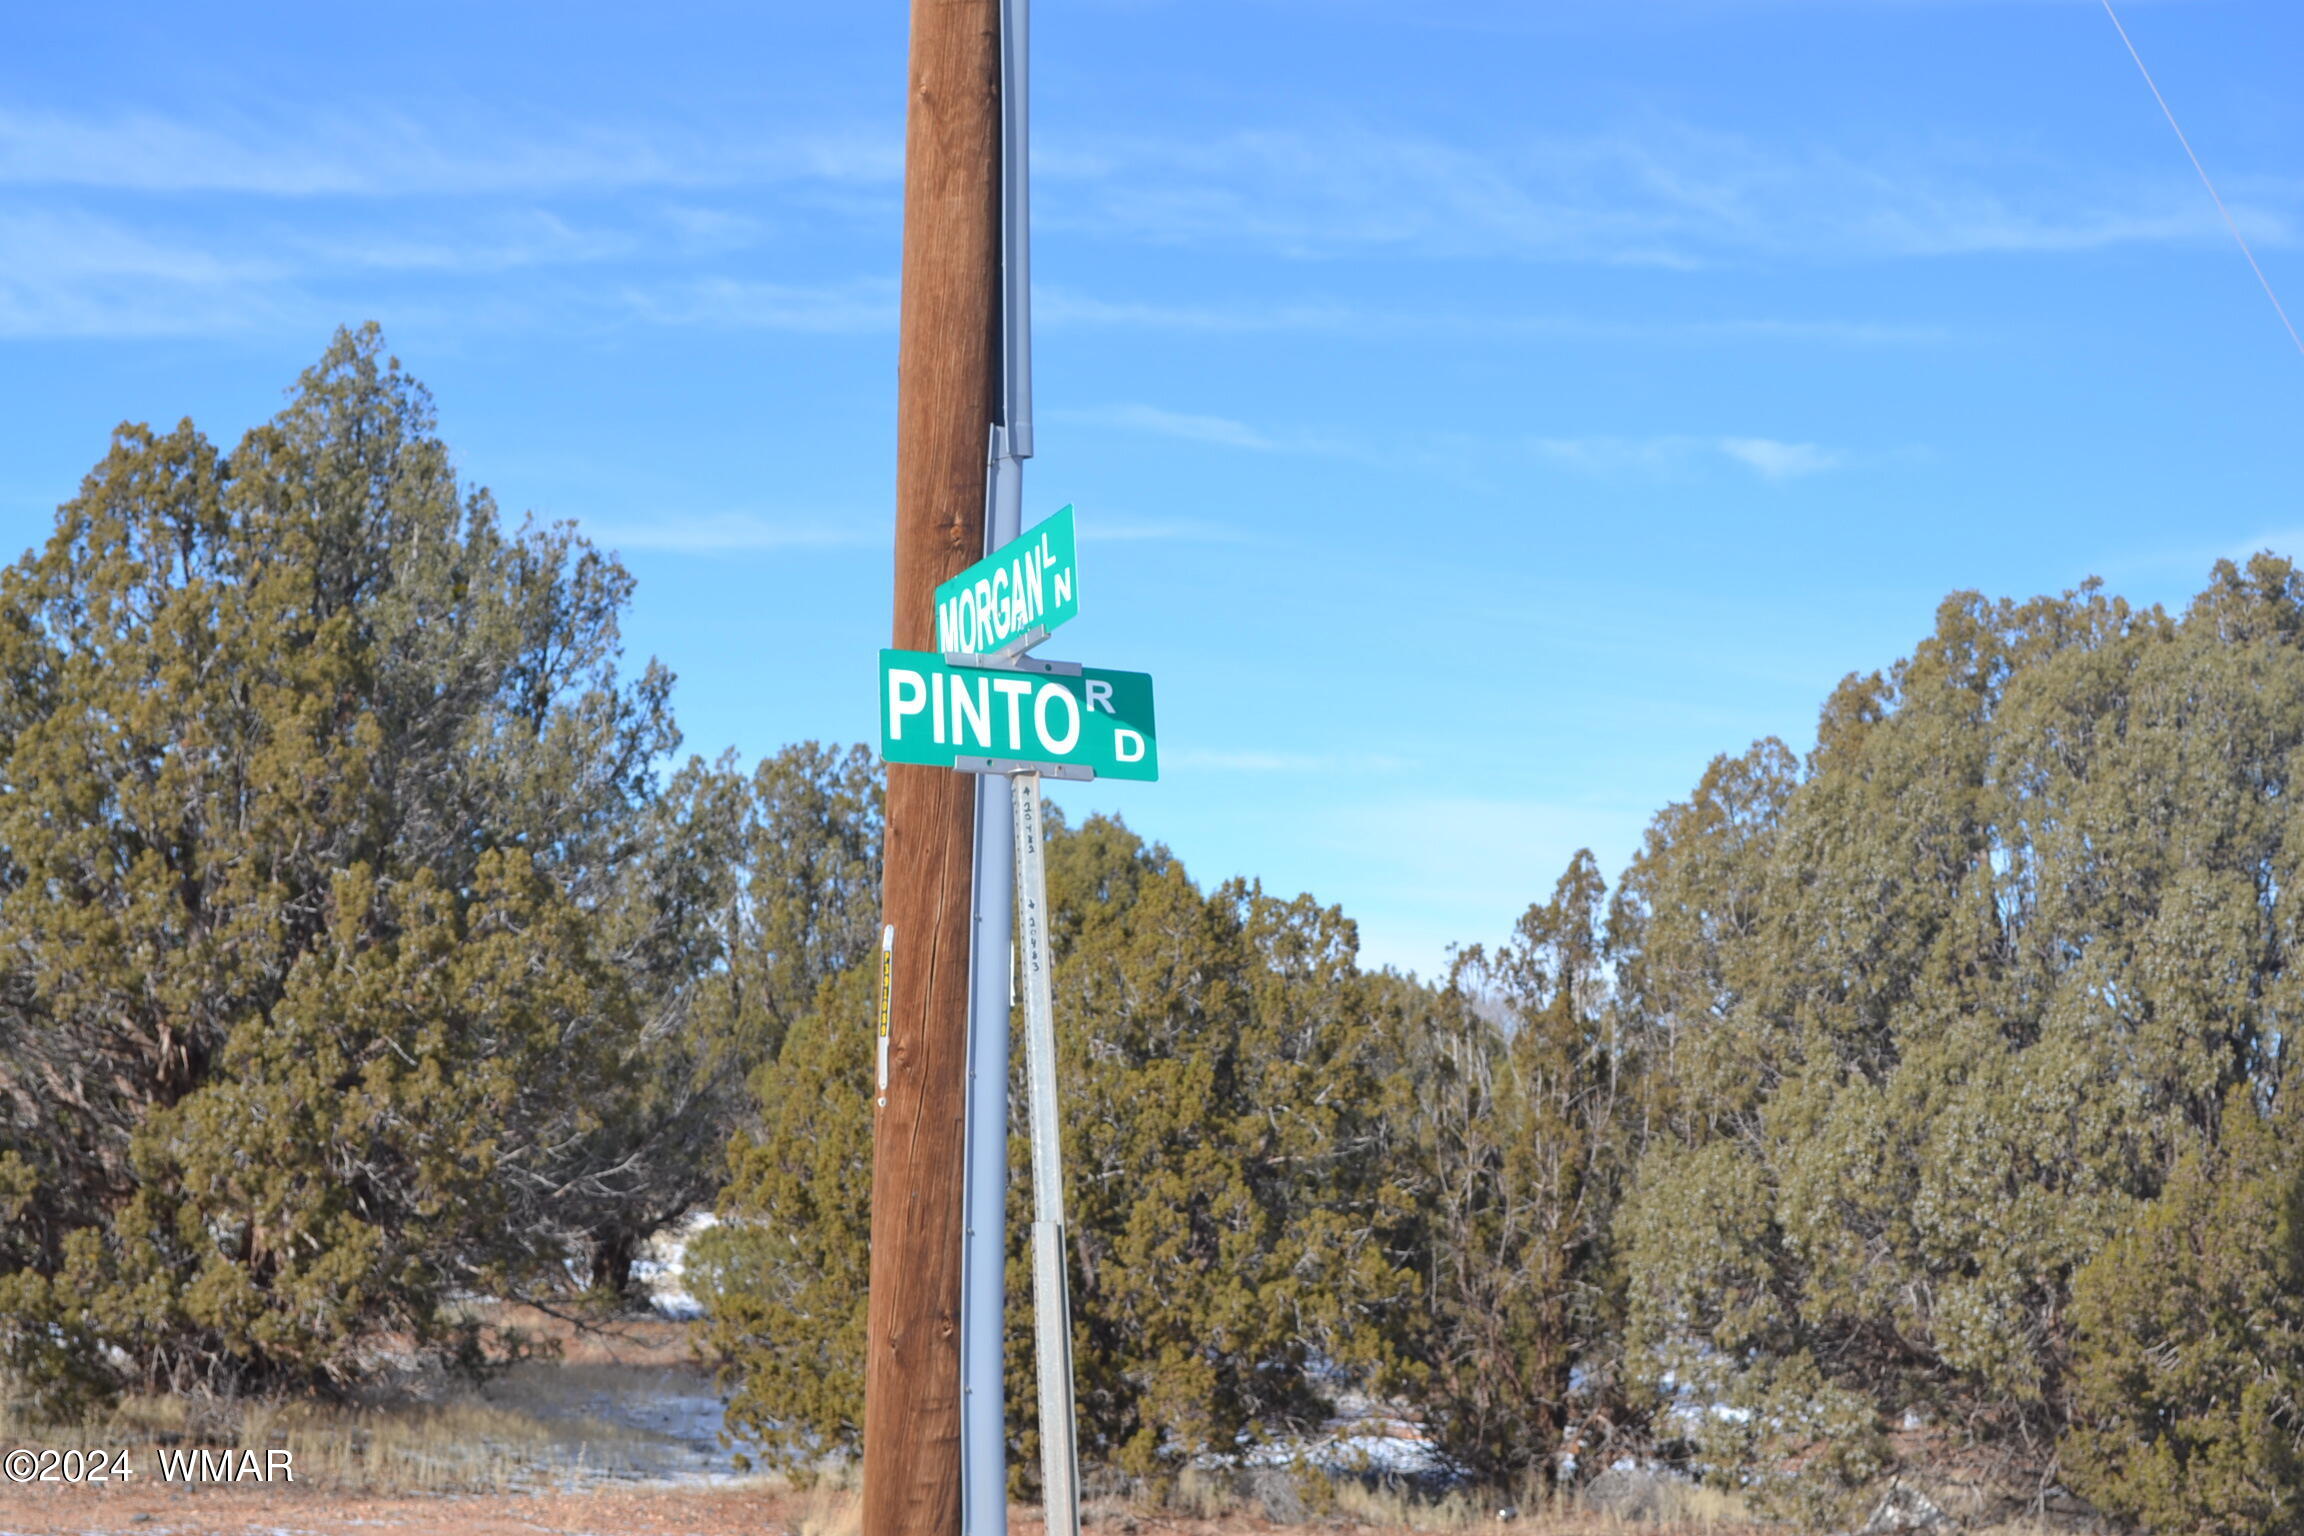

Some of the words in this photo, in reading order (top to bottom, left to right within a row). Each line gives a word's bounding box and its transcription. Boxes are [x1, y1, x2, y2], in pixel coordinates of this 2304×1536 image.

[939, 545, 1044, 654] MORGAN
[888, 668, 1080, 755] PINTO
[1085, 679, 1145, 762] RD
